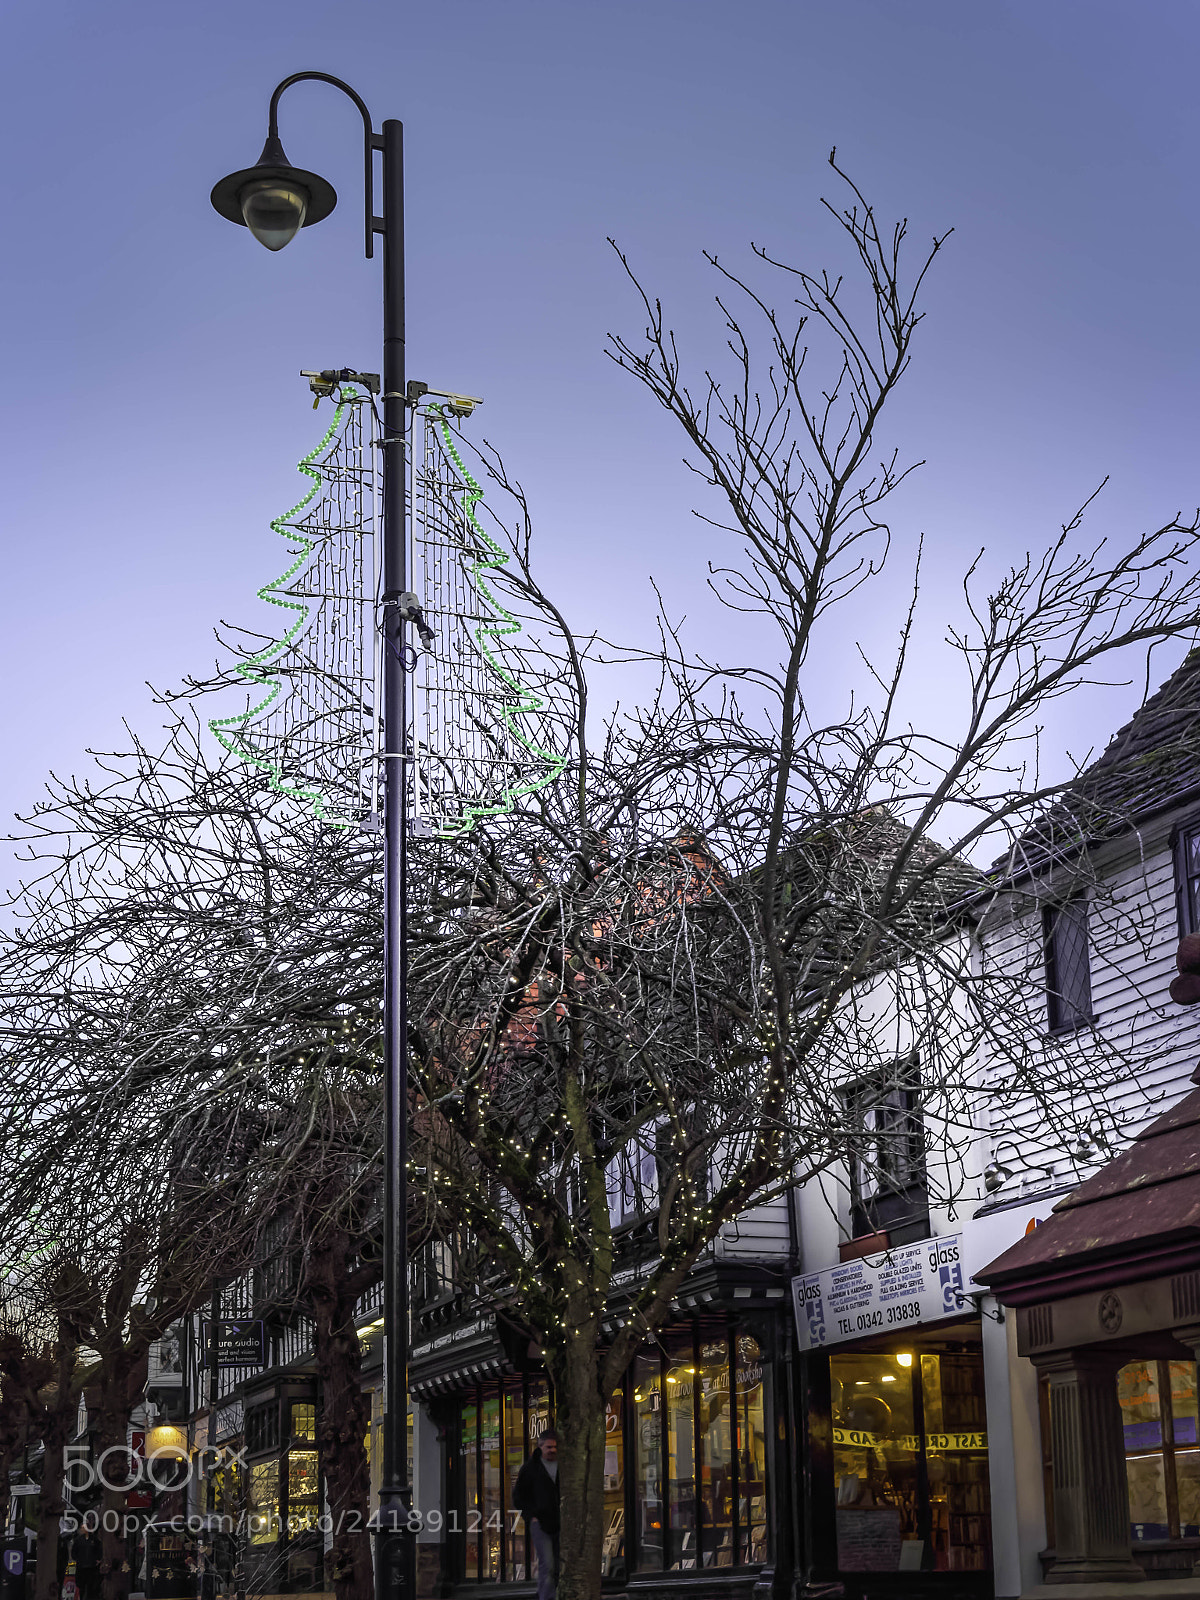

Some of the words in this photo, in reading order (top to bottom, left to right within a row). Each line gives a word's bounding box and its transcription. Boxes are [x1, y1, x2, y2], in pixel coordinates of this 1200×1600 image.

[929, 1242, 960, 1273] glass
[878, 1270, 893, 1280] DOUBLE
[894, 1266, 909, 1276] GLAZED
[910, 1262, 922, 1272] UNITS
[798, 1279, 821, 1307] glass
[851, 1284, 873, 1294] HARDWOOD
[889, 1282, 907, 1292] GLAZING
[908, 1278, 924, 1288] SERVICE
[838, 1316, 856, 1335] TEL.
[857, 1311, 883, 1331] 01342
[887, 1302, 921, 1324] 313838
[235, 1337, 260, 1347] audio
[9, 1552, 20, 1570] P
